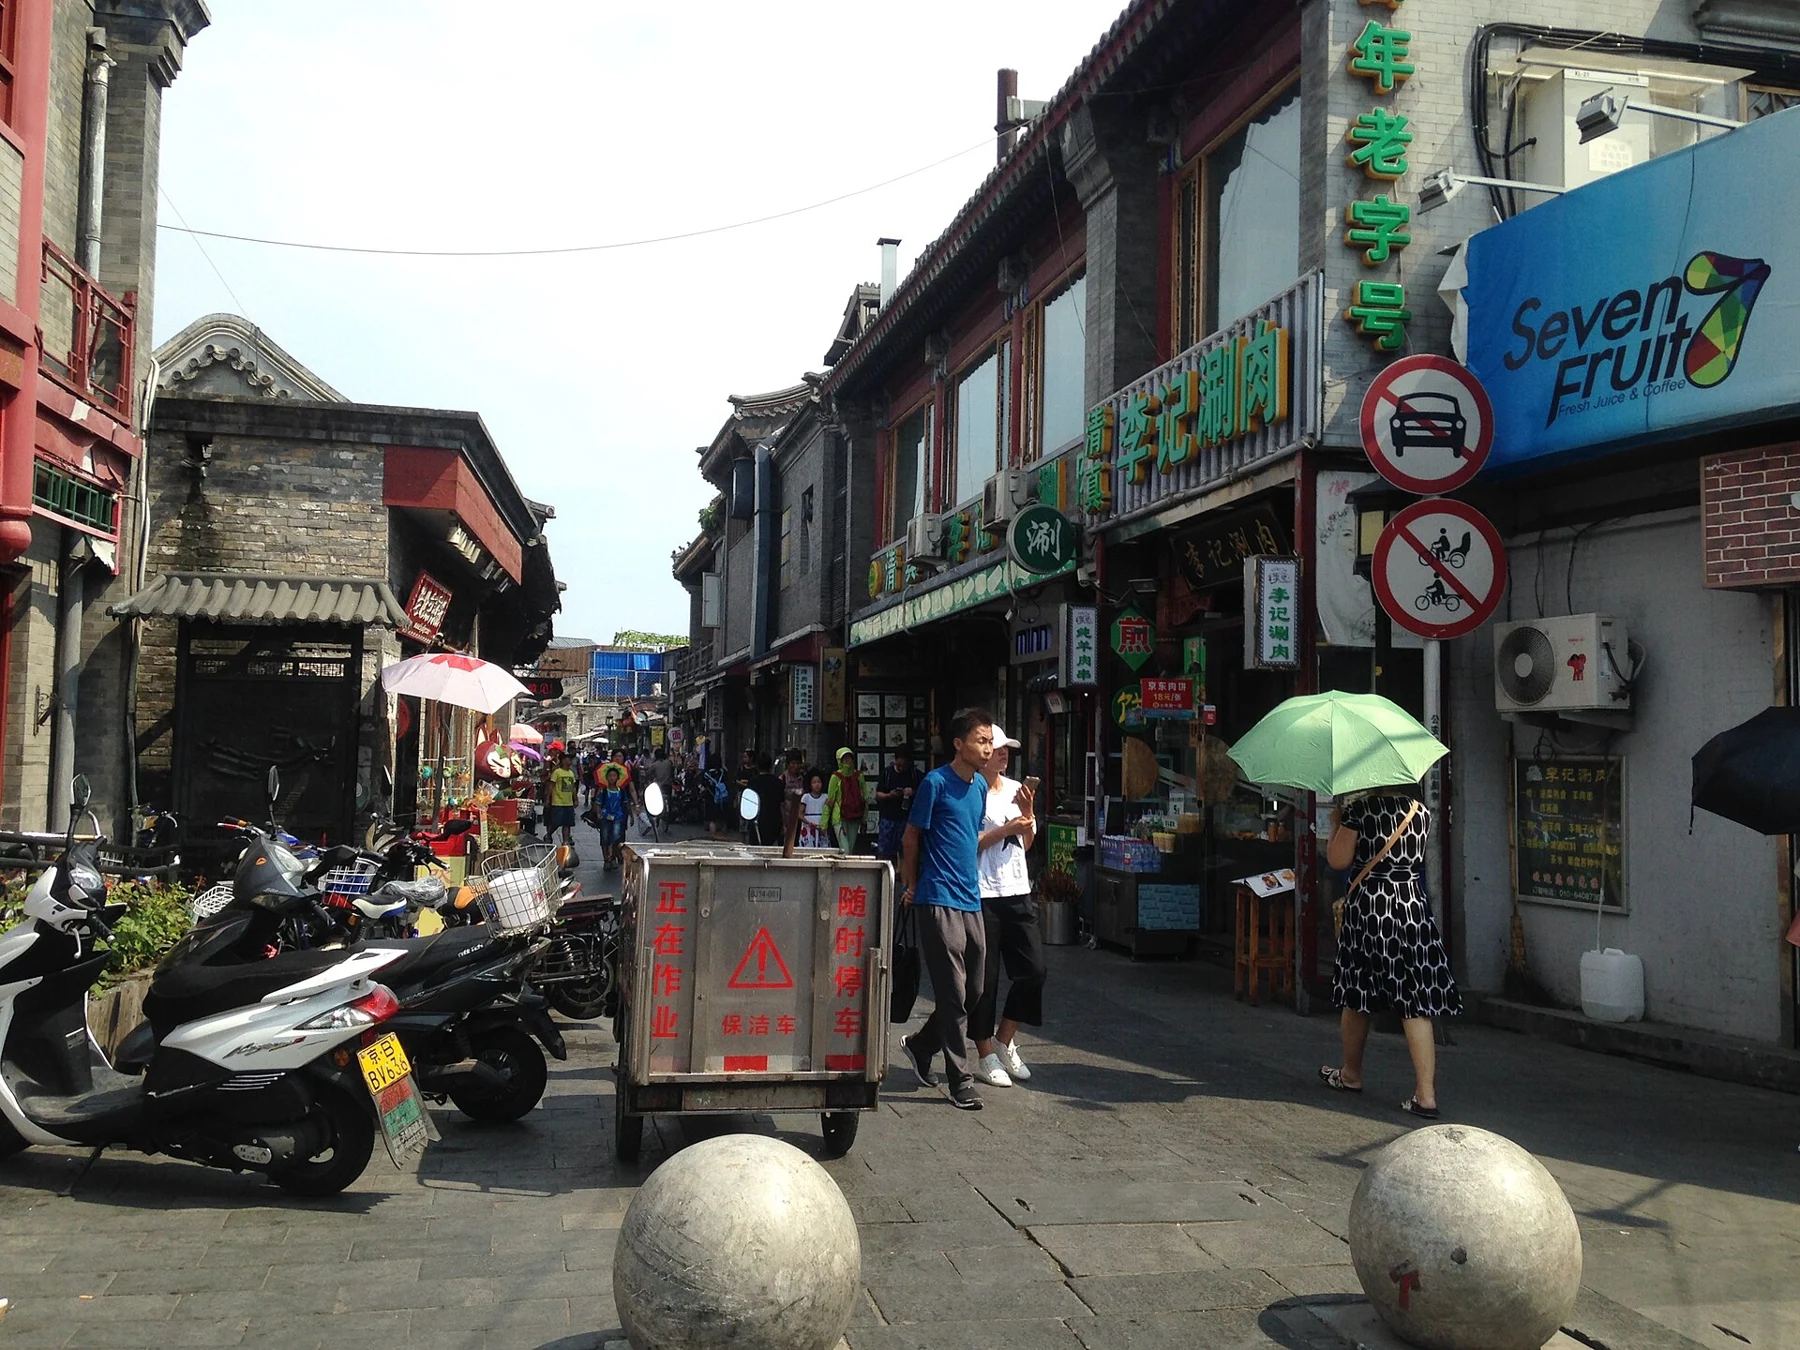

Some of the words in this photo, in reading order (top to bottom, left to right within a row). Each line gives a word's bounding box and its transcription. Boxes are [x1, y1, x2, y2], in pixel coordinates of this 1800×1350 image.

[1345, 0, 1415, 351] 年老字号
[1504, 275, 1682, 371] Seven
[1117, 320, 1288, 485] 李记涮肉
[1545, 311, 1692, 430] Fruit
[1557, 398, 1591, 418] Fresh
[1593, 391, 1625, 409] Juice
[1629, 389, 1638, 400] &
[1643, 379, 1686, 398] Coffee
[1085, 406, 1113, 515] 清真
[1026, 518, 1061, 561] 涮
[1075, 627, 1092, 681] 纯羊肉串
[1118, 616, 1152, 653] 煎
[1268, 587, 1291, 660] 李记涮肉
[1147, 680, 1187, 692] 京东肉饼
[652, 881, 687, 1039] 正在作业
[834, 885, 868, 1039] 随时停车
[722, 1014, 796, 1037] 保洁车
[368, 1053, 408, 1091] BV636
